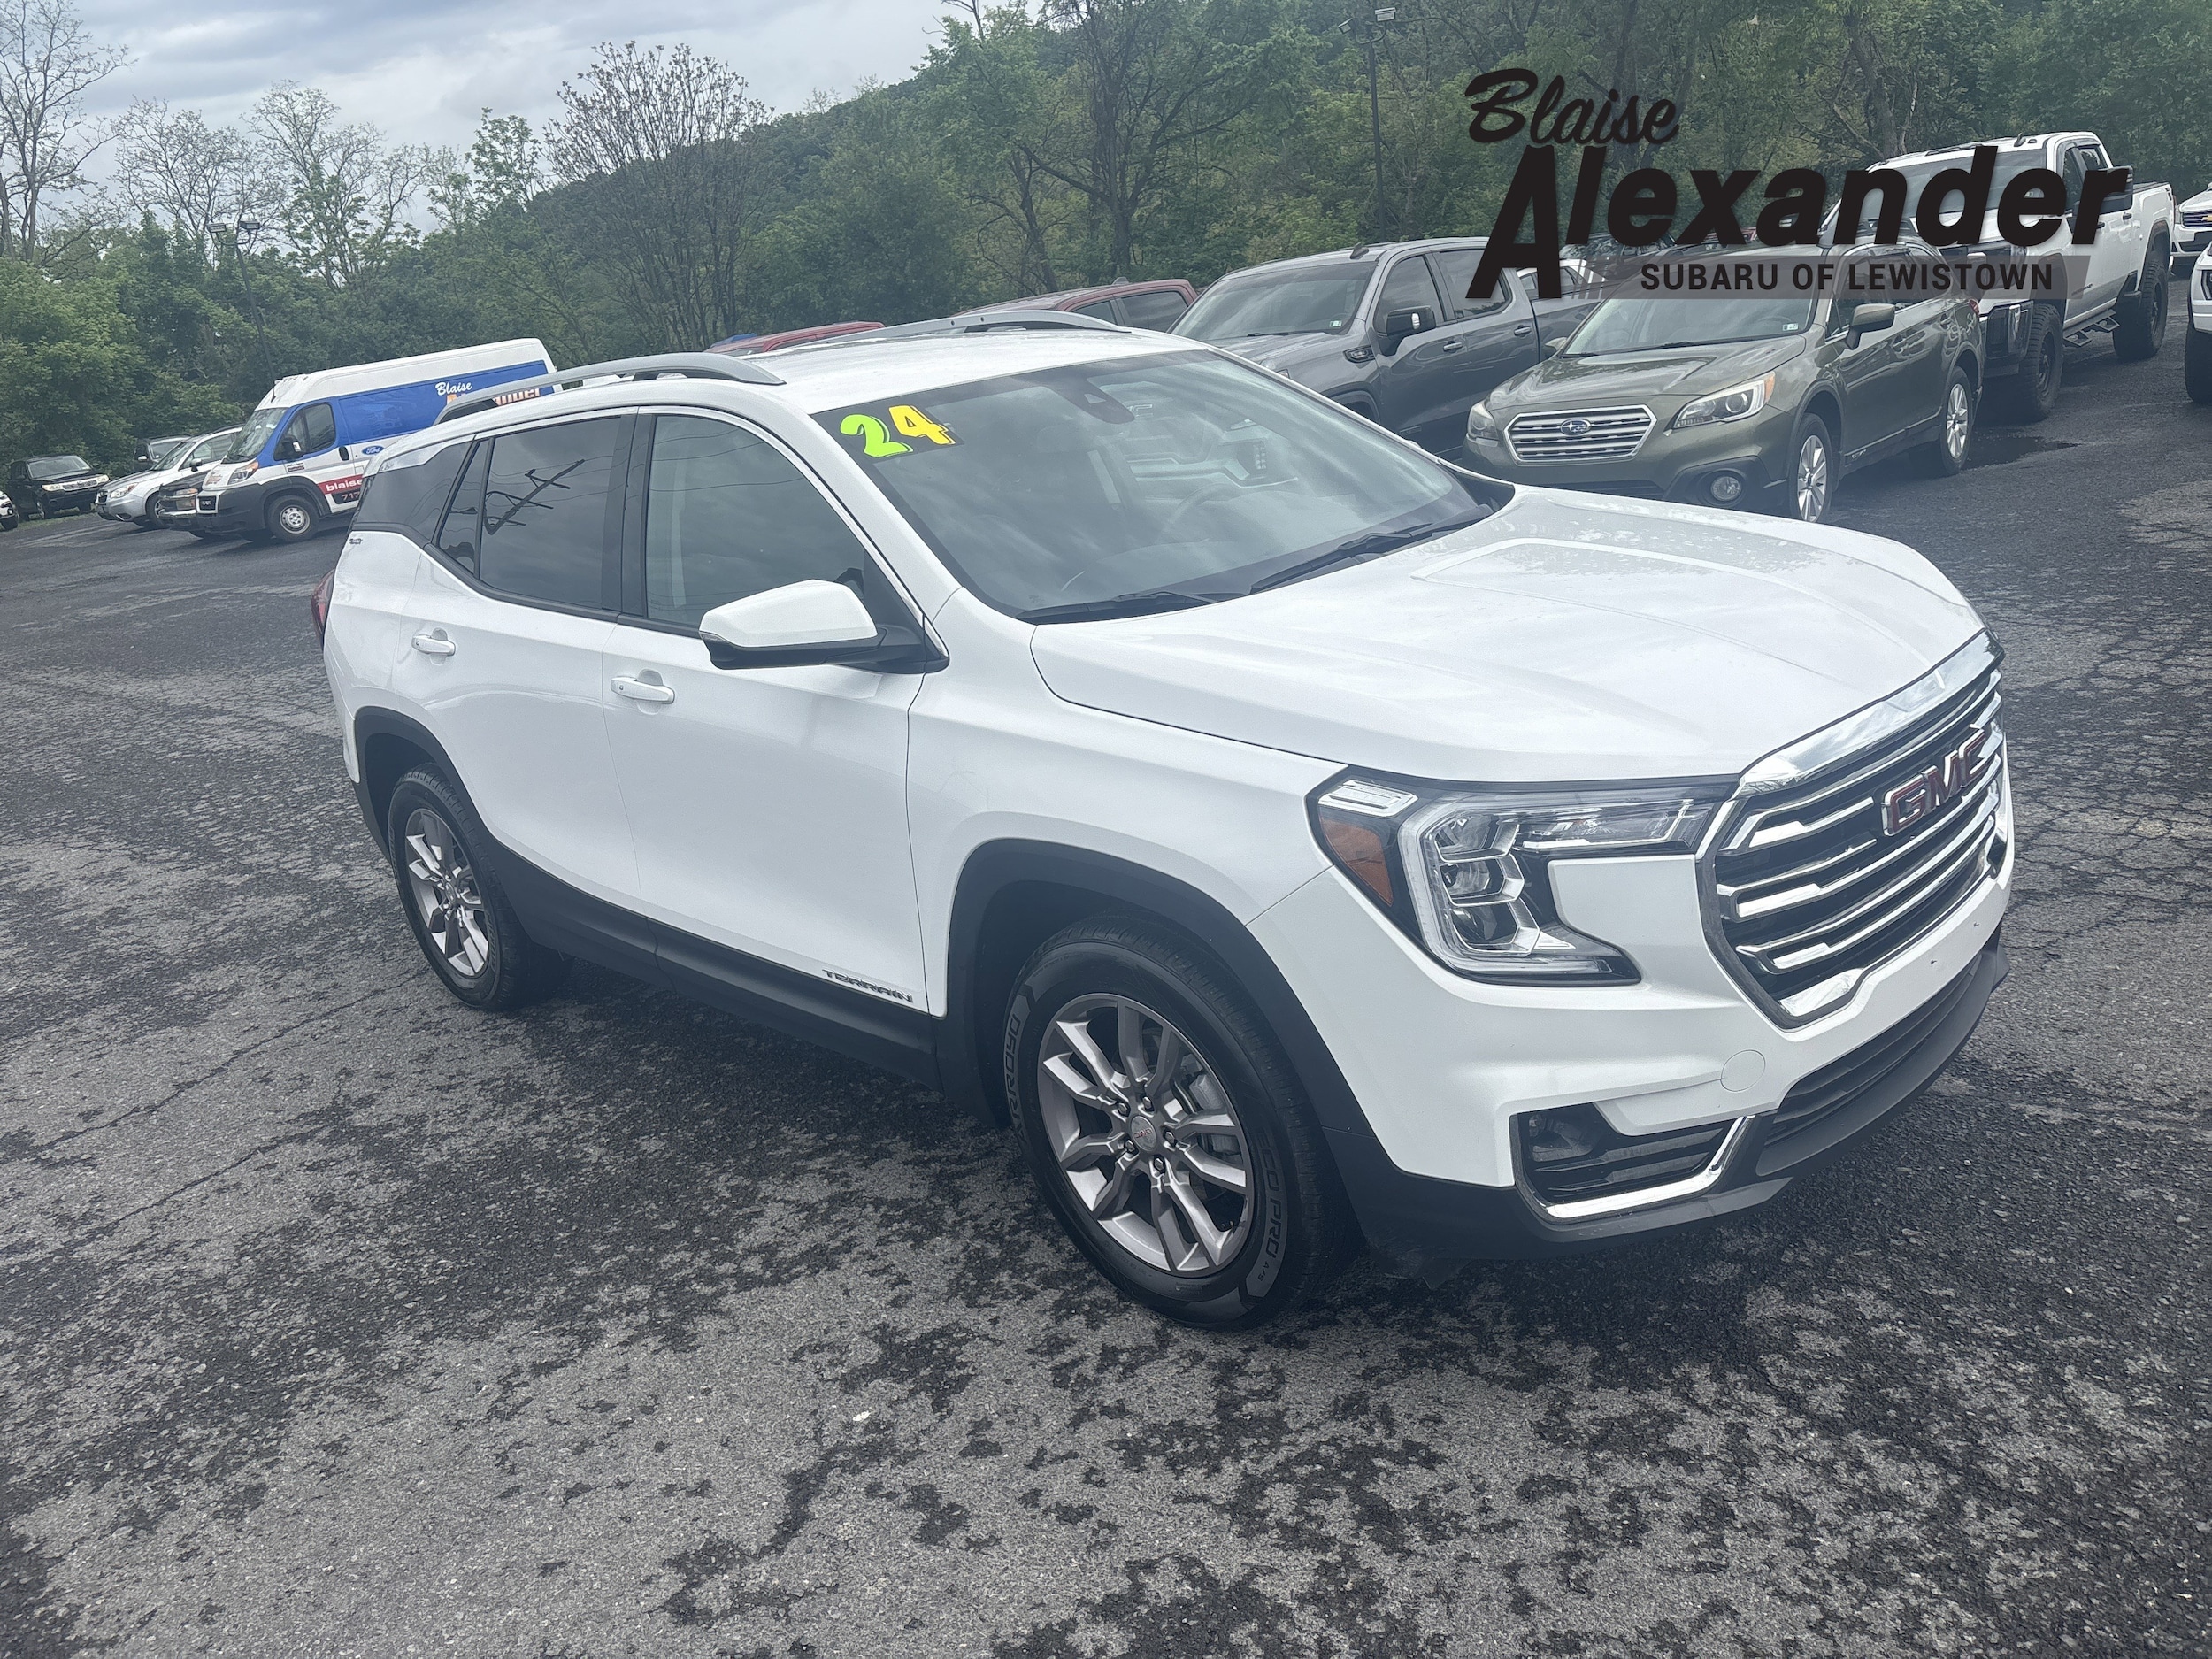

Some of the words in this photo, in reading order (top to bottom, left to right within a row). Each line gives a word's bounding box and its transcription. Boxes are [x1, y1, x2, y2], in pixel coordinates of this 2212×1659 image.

[435, 382, 472, 396] Blaise
[841, 405, 956, 457] 24
[1881, 729, 1990, 836] GMC
[822, 968, 913, 1003] TERRAIN
[1005, 1013, 1028, 1145] ARROYO
[1265, 1197, 1282, 1259] PRO
[1257, 1261, 1270, 1282] A/S
